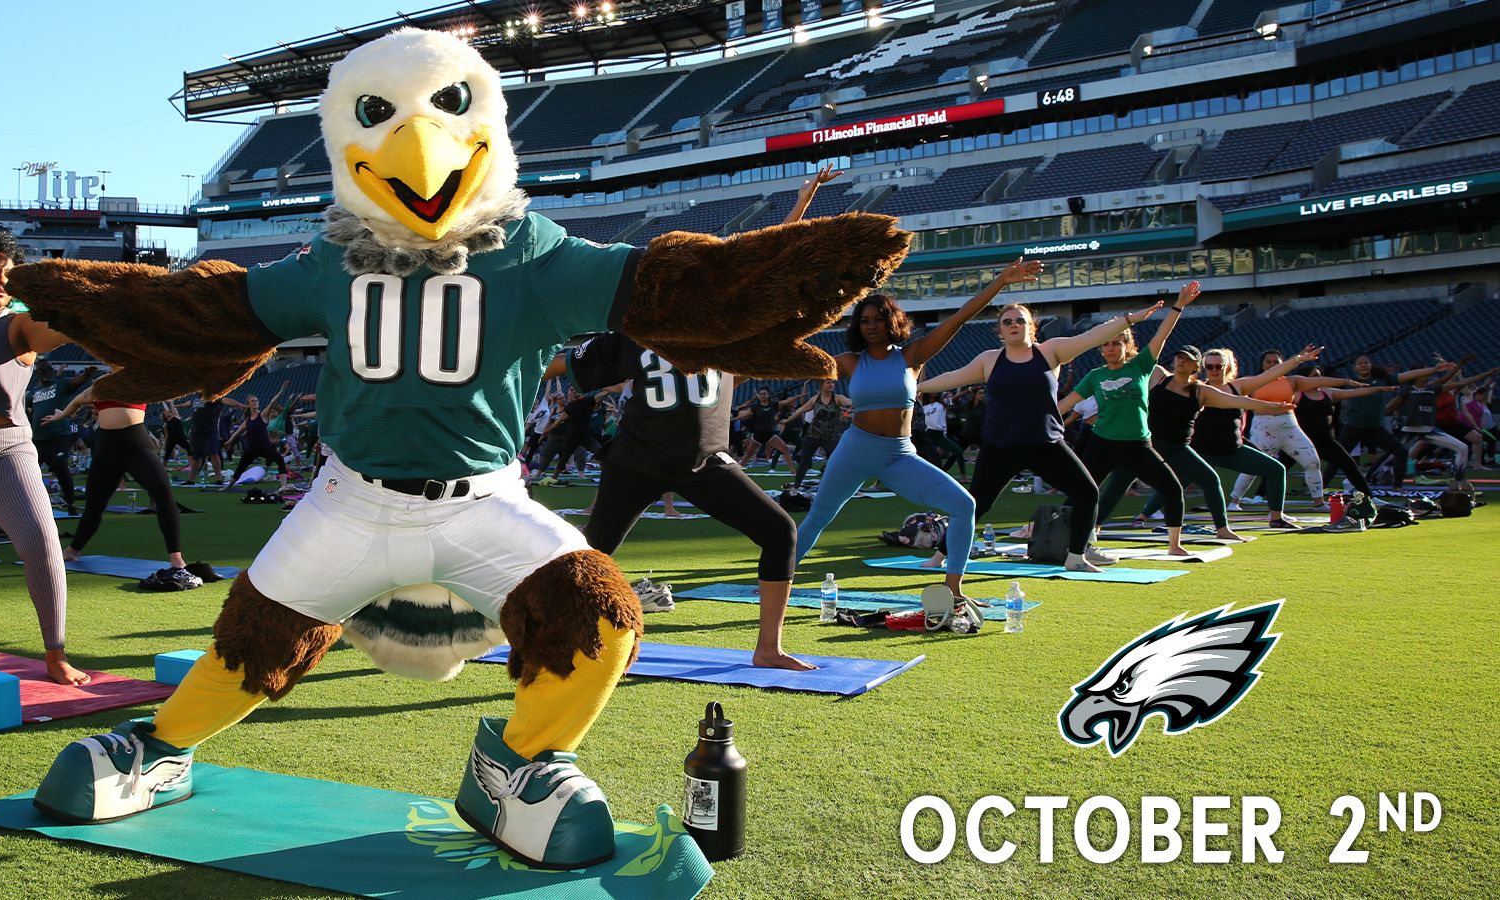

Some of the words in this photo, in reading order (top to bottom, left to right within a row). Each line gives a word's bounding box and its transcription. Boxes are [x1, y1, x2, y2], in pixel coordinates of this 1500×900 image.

[1042, 87, 1074, 105] 6:48
[824, 124, 864, 141] Lincoln
[865, 115, 916, 134] Financial
[917, 109, 947, 126] Field
[34, 170, 99, 207] Lite
[262, 199, 280, 207] LIVE
[280, 195, 320, 205] FEARLESS
[1300, 199, 1345, 215] LIVE
[1350, 181, 1468, 208] FEARLESS
[1024, 243, 1088, 255] Independence
[347, 272, 485, 387] 00
